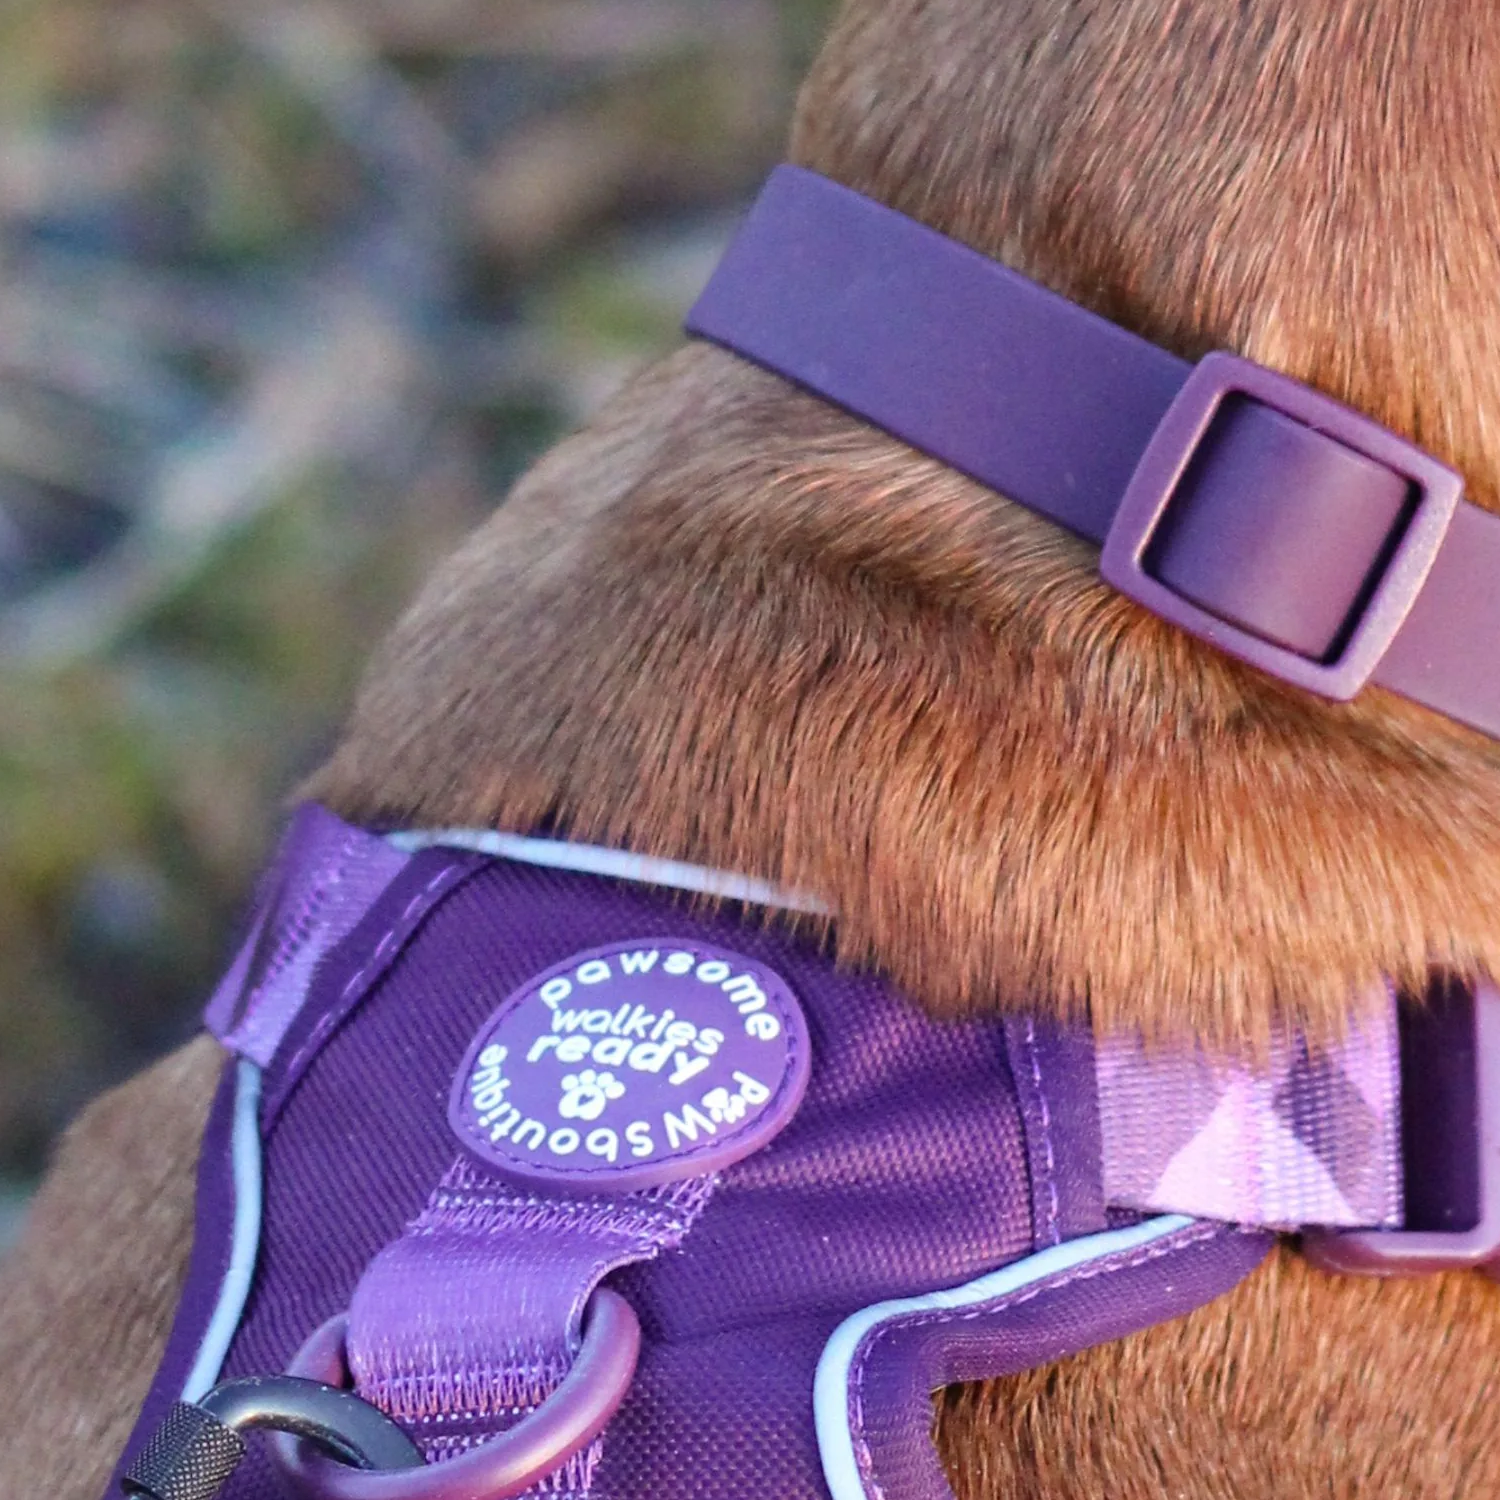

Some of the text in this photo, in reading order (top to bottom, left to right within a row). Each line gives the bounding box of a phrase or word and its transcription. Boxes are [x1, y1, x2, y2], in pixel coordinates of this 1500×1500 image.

[540, 950, 780, 1040] pawsome
[552, 1004, 725, 1055] walkies
[526, 1034, 711, 1085] ready
